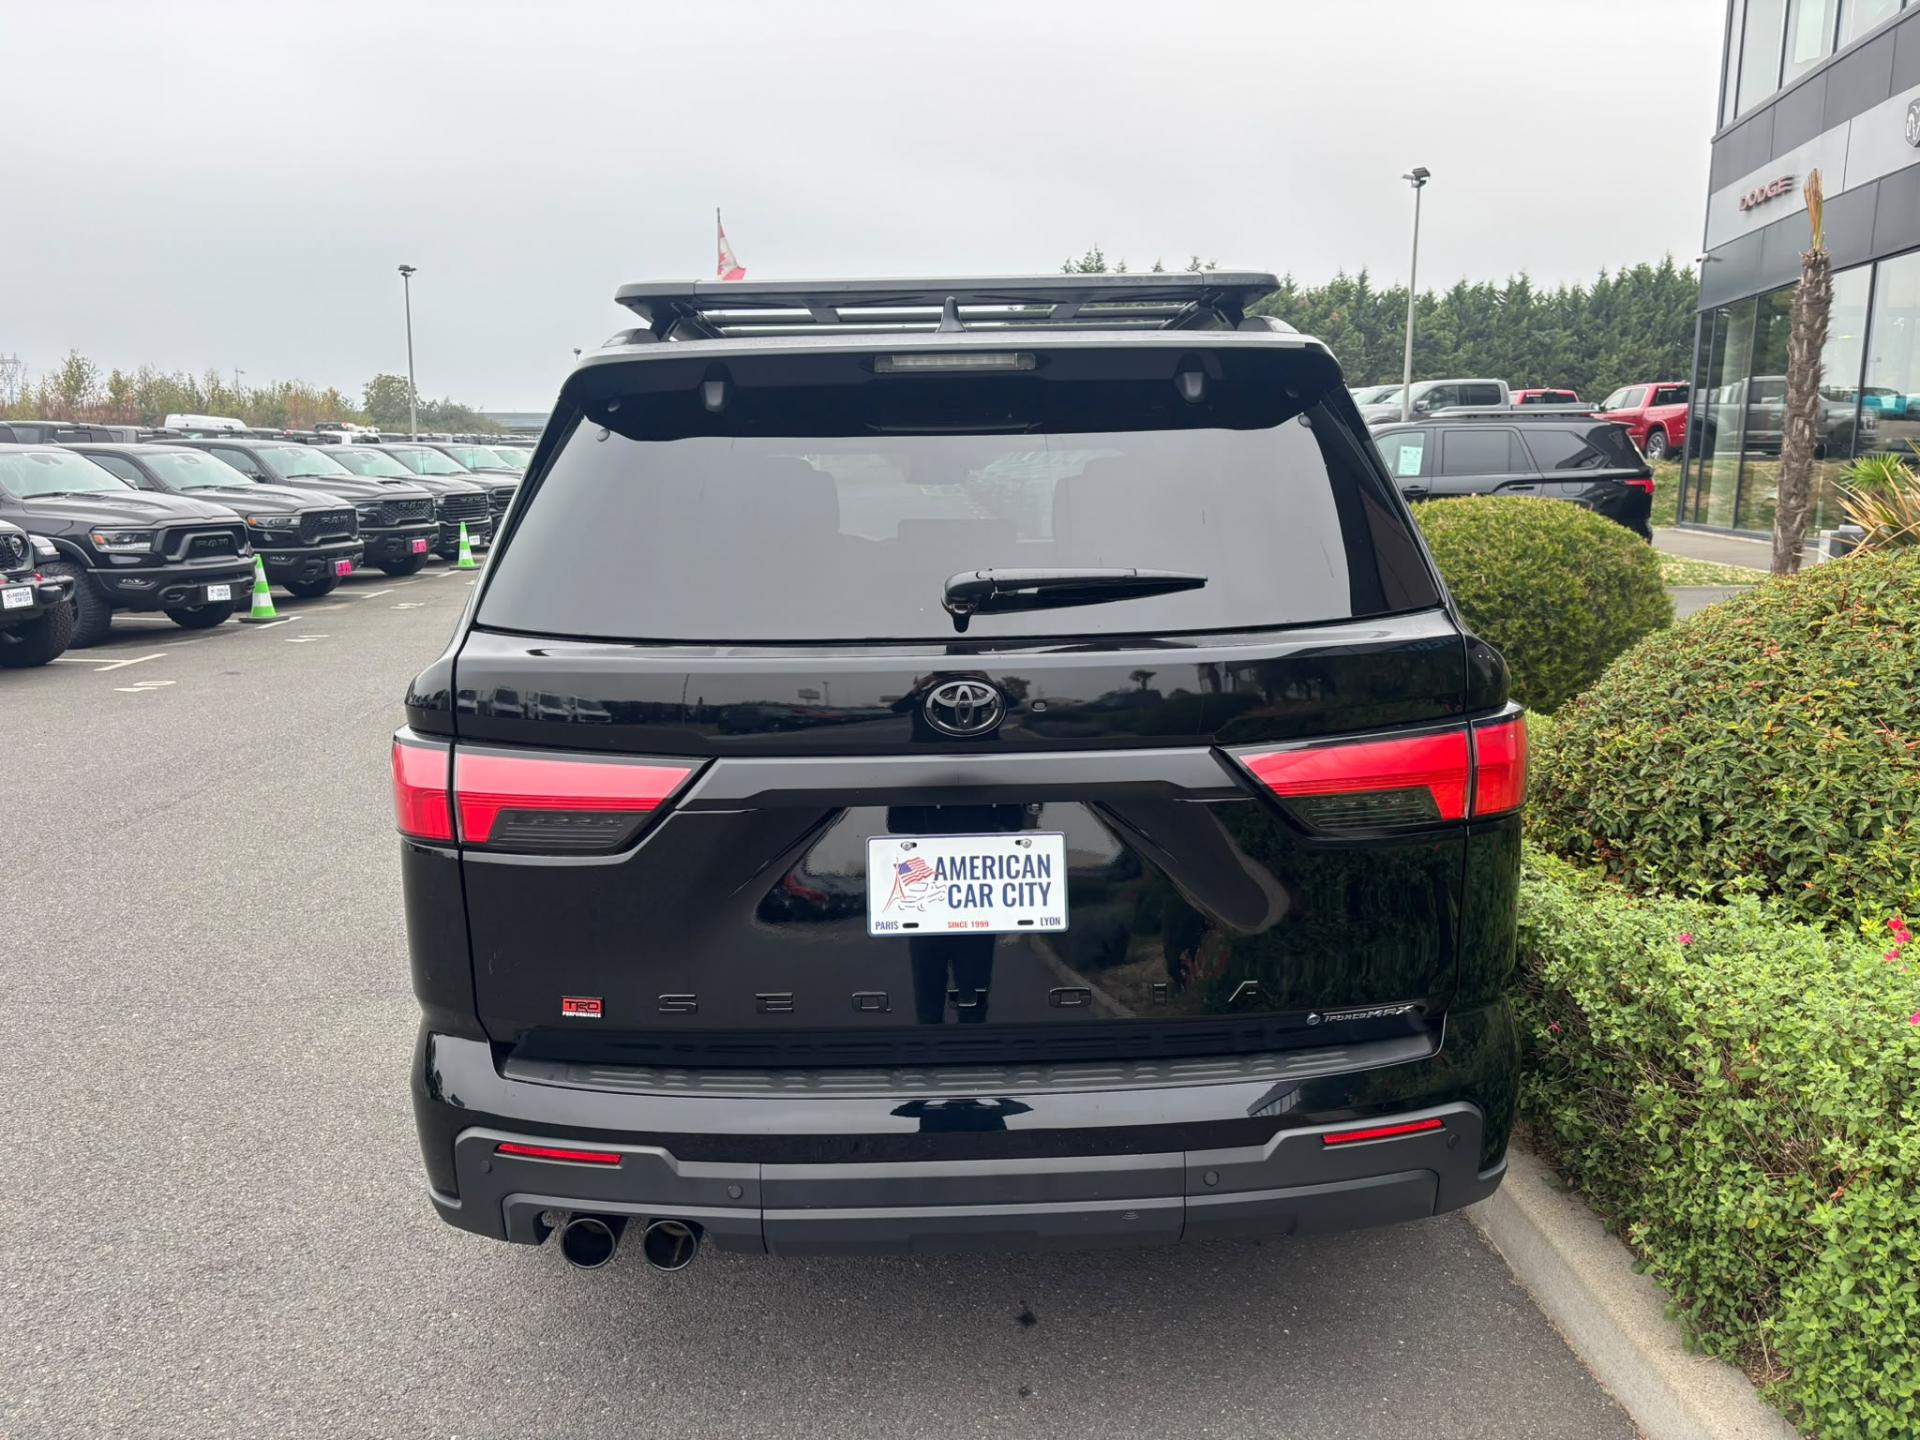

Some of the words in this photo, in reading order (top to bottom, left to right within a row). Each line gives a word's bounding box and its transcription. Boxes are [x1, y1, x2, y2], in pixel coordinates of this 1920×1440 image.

[1739, 176, 1794, 211] DODGE
[934, 854, 1051, 881] AMERICAN
[948, 884, 994, 909] CAR
[1003, 882, 1052, 907] CITY
[875, 920, 899, 931] PARIS
[947, 921, 968, 929] SINCE
[971, 920, 990, 929] 1999
[1040, 916, 1061, 927] LYON
[564, 1000, 600, 1012] TRD
[657, 979, 1273, 1014] SEQUOIA
